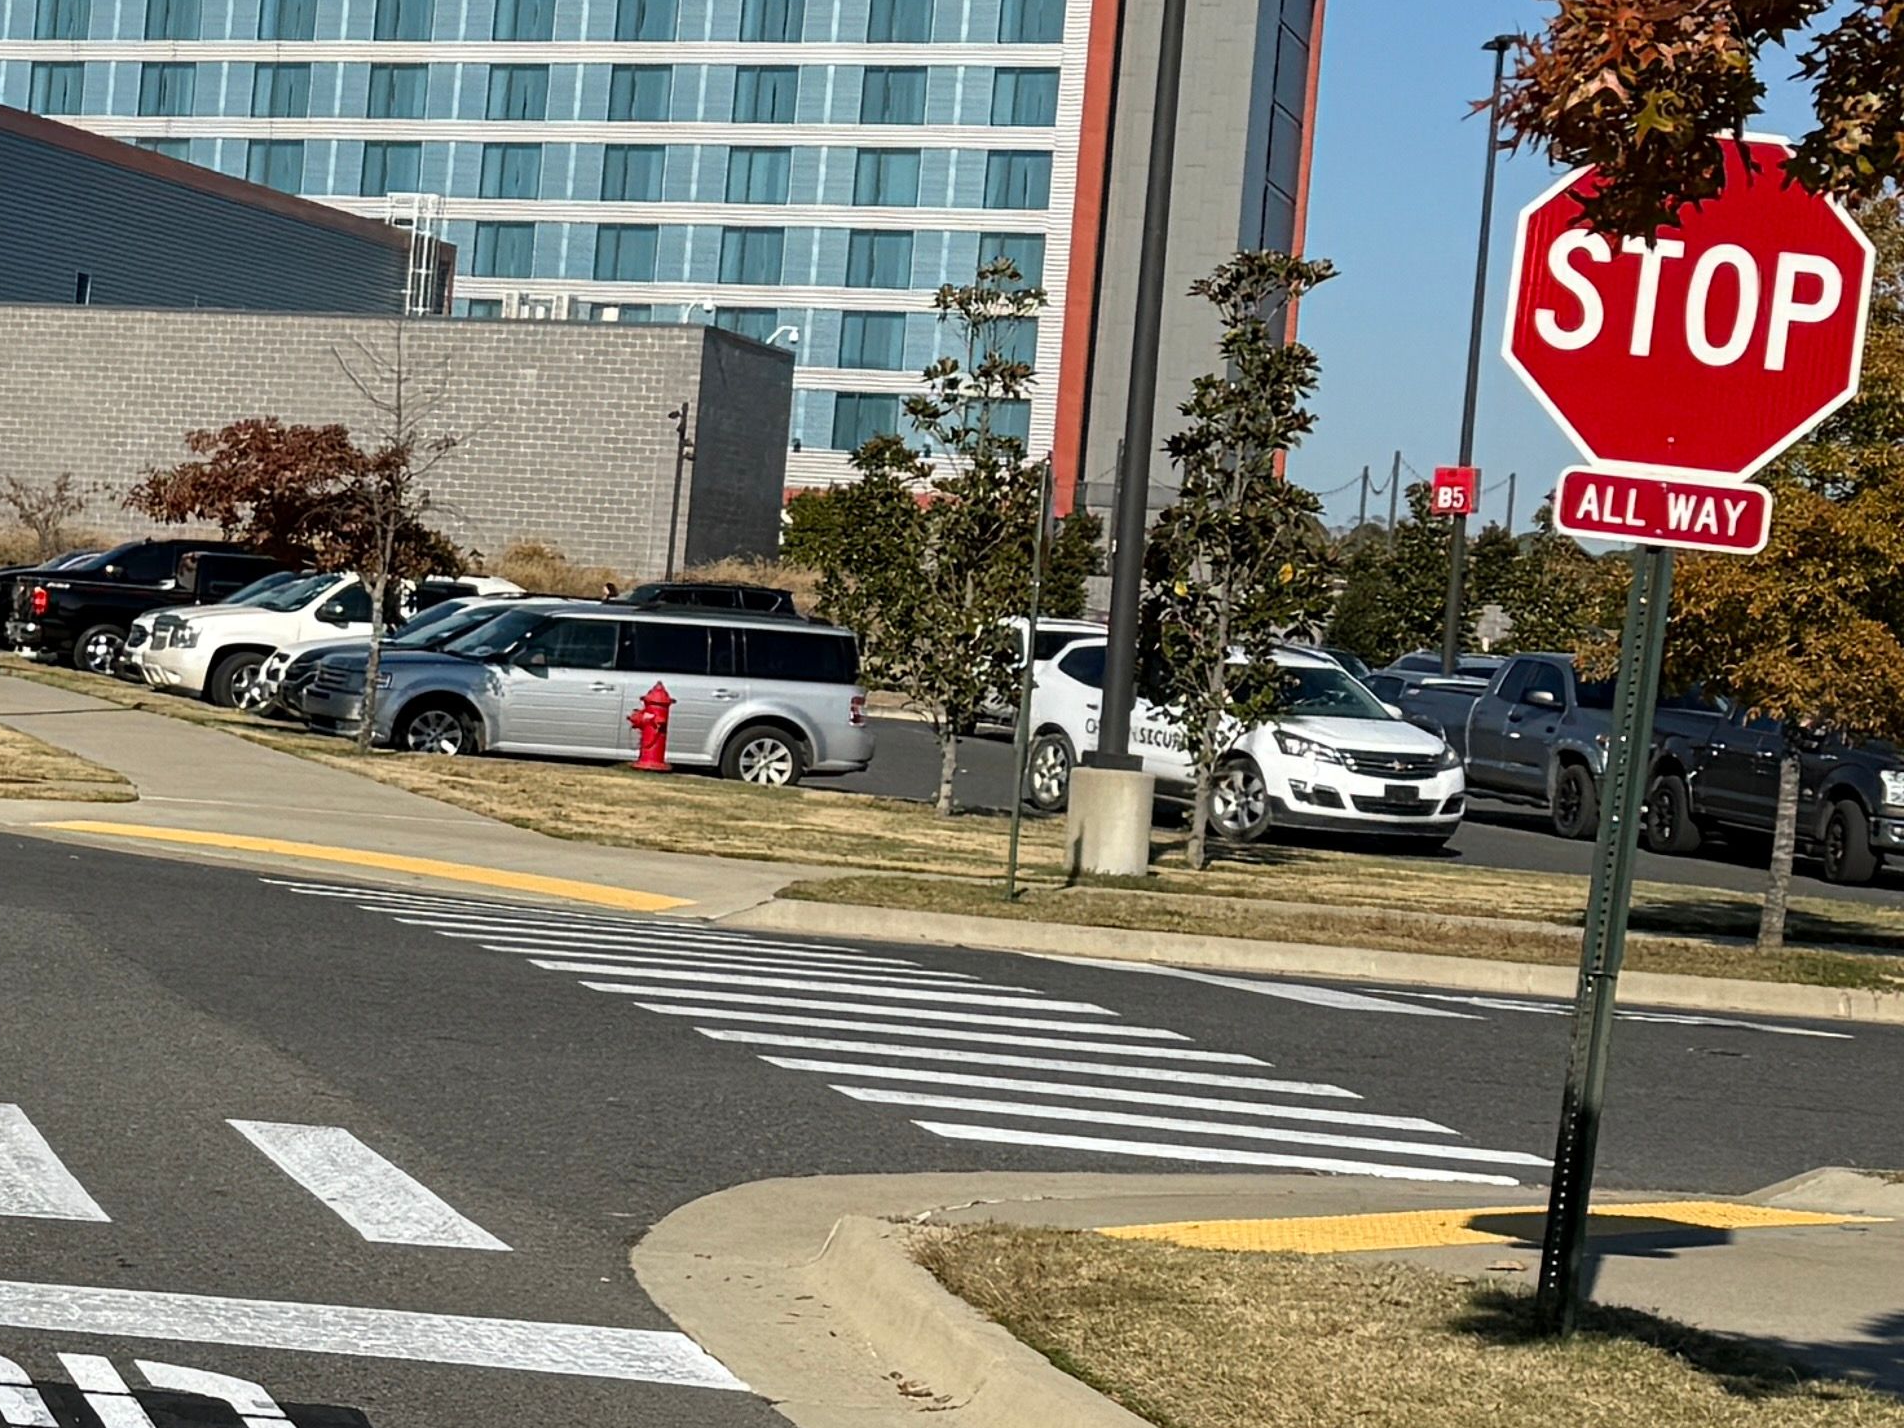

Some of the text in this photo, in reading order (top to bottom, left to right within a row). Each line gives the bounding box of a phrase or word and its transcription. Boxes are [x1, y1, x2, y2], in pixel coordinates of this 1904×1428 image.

[1534, 228, 1843, 372] STOP
[1438, 486, 1464, 508] B5
[1576, 484, 1748, 537] ALL WAY
